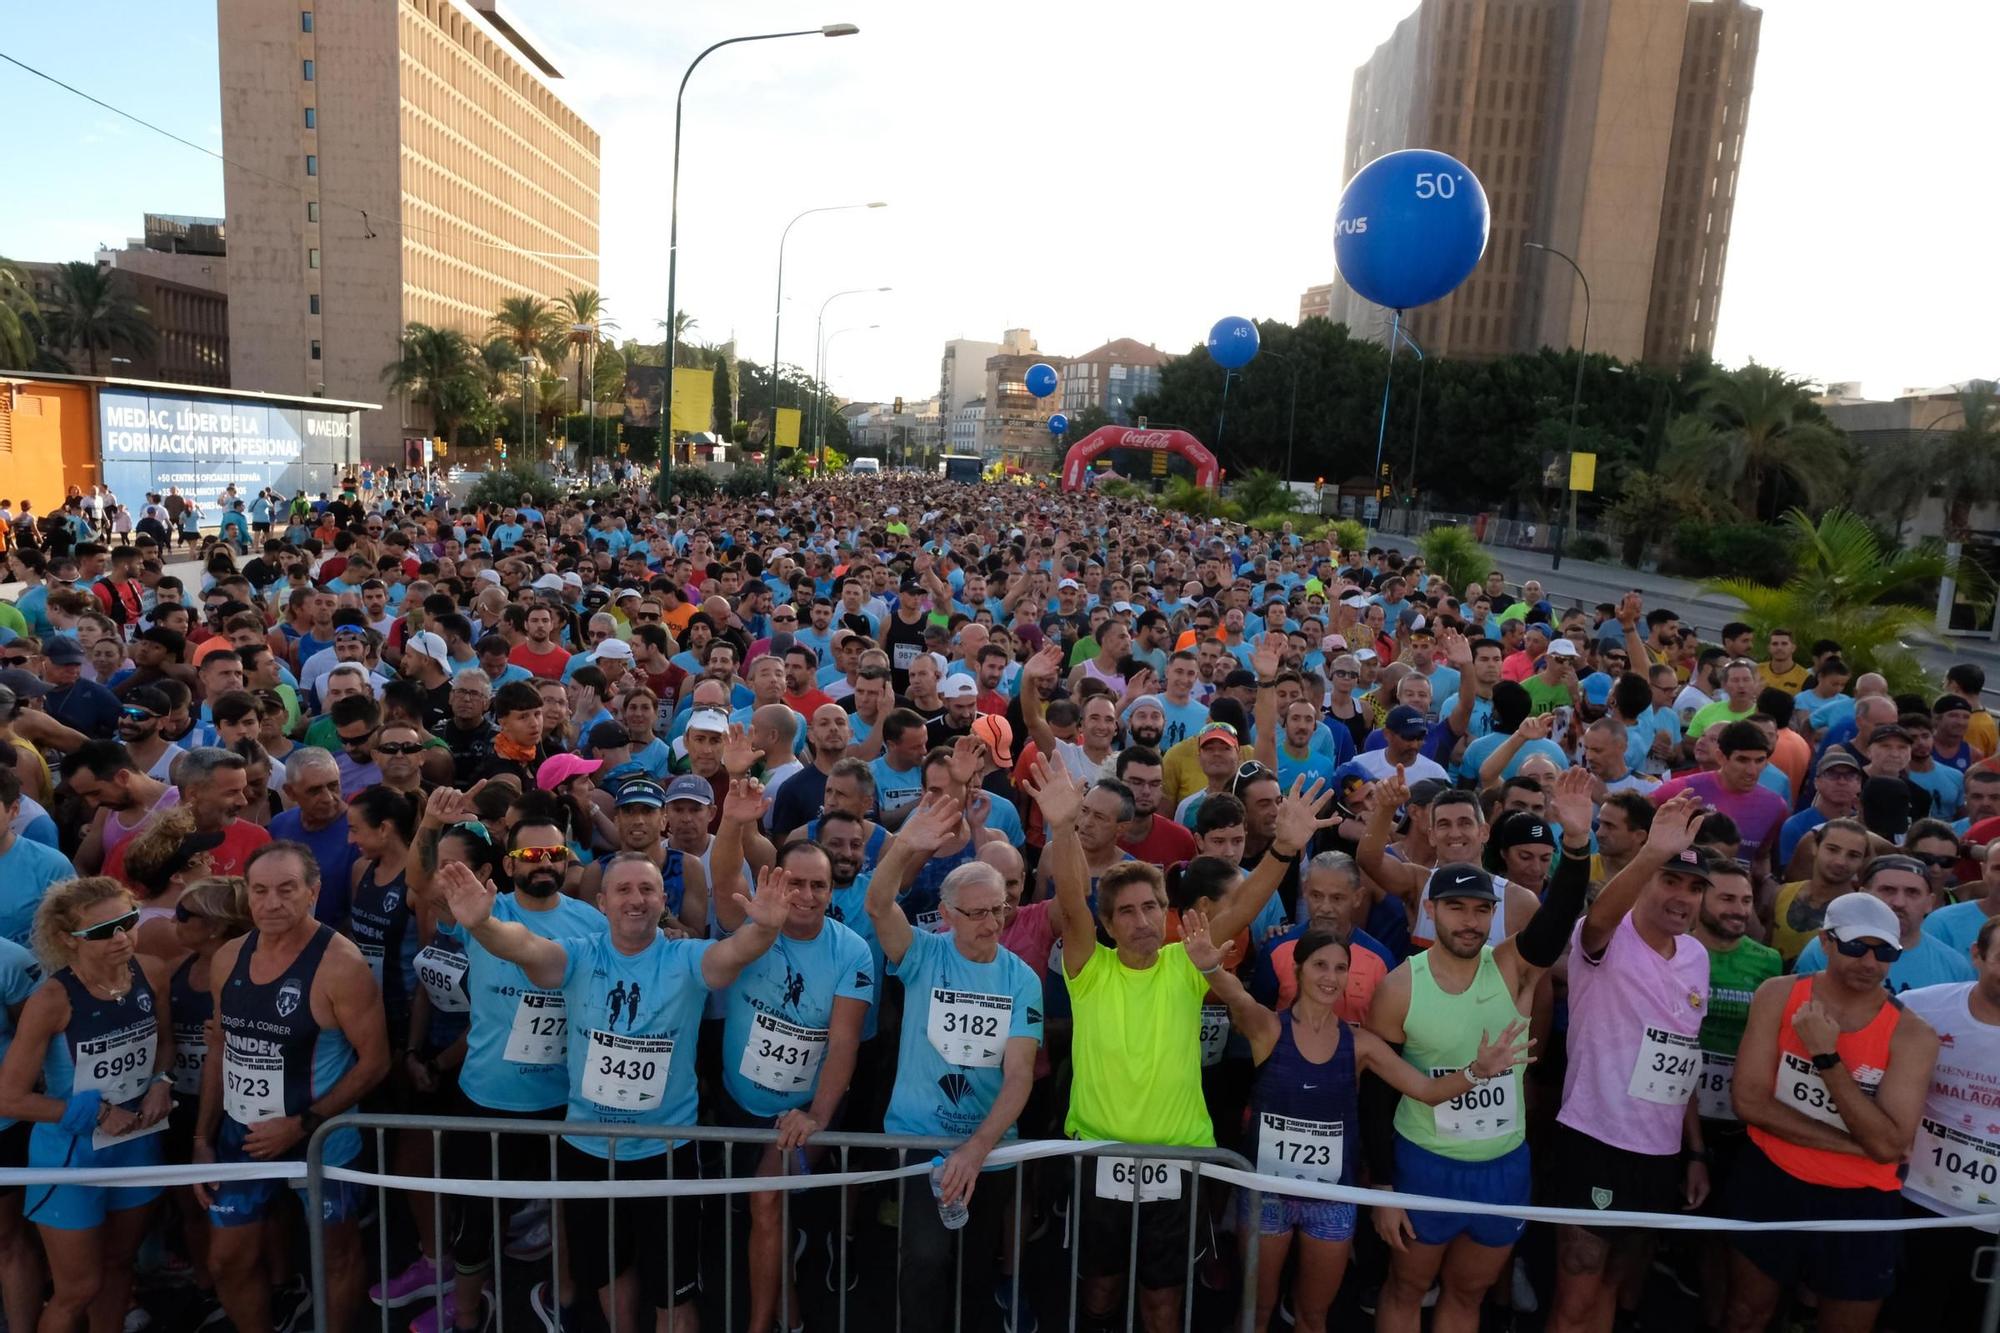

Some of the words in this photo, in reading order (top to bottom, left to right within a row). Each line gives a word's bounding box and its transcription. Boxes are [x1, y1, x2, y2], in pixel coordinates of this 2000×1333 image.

[107, 406, 173, 432] MEDAC,
[176, 407, 218, 432] LÍDER
[220, 414, 239, 433] DE
[242, 415, 259, 435] LA
[315, 420, 352, 438] MEDAC
[108, 431, 208, 455] FORMACIÓN
[212, 437, 300, 457] PROFESIONAL
[421, 966, 452, 992] 6995
[501, 986, 515, 997] 43
[523, 995, 545, 1008] 43
[934, 989, 956, 1004] 43
[750, 998, 764, 1011] 43
[247, 1021, 255, 1029] A
[256, 1020, 291, 1035] CORRER
[530, 1016, 568, 1036] 127
[757, 1014, 777, 1032] 43
[943, 1012, 998, 1037] 3182
[593, 1031, 614, 1048] 43
[614, 1037, 646, 1046] CARRERA
[1646, 1027, 1668, 1044] 43
[81, 1040, 107, 1055] 43
[759, 1039, 810, 1066] 3431
[94, 1047, 147, 1079] 6993
[600, 1055, 655, 1080] 3430
[1652, 1052, 1696, 1077] 3241
[1785, 1054, 1811, 1075] 43
[228, 1071, 270, 1097] 6723
[1450, 1087, 1505, 1111] 9600
[1264, 1115, 1285, 1131] 43
[1922, 1117, 1947, 1139] 43
[1275, 1140, 1330, 1165] 1723
[1113, 1162, 1168, 1184] 6506
[1932, 1146, 1998, 1185] 1040
